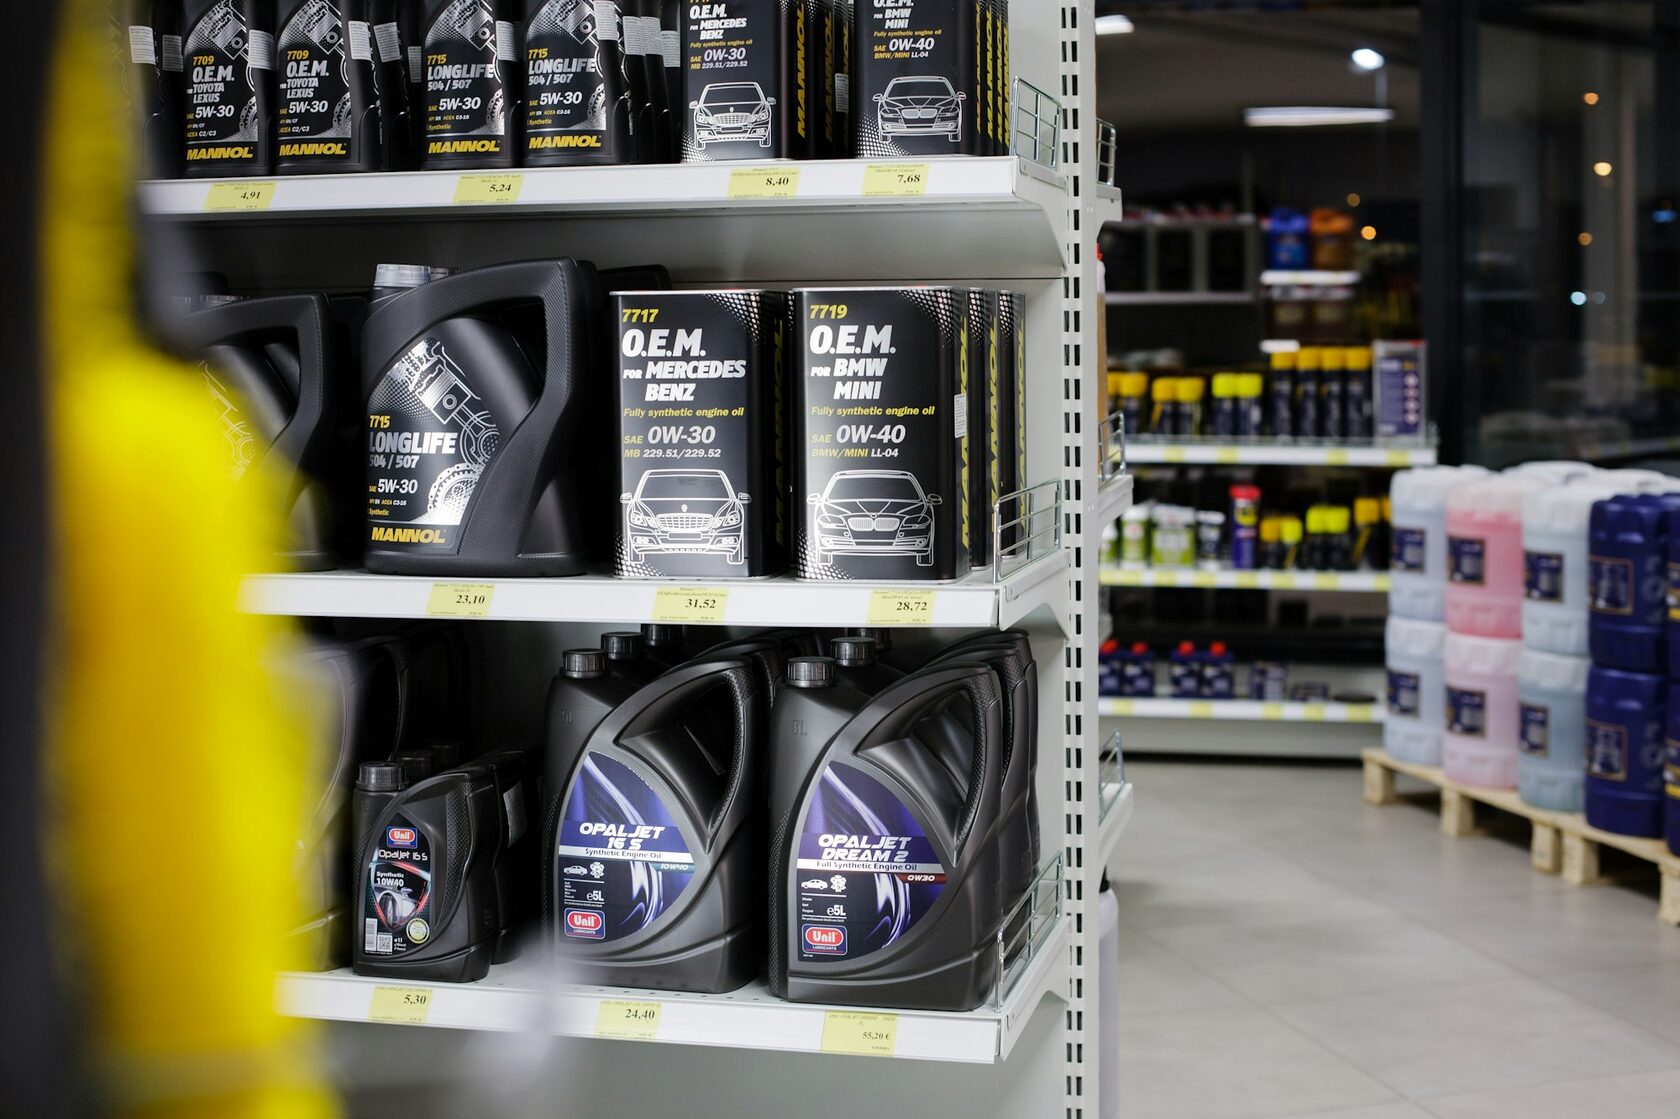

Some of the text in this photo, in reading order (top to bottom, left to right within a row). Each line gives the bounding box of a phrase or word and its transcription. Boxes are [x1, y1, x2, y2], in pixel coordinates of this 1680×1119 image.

[690, 4, 727, 19] O.E.M.
[885, 8, 911, 18] BMW
[700, 18, 747, 30] MERCEDES
[885, 19, 909, 29] MINI
[700, 30, 724, 40] BENZ
[889, 37, 935, 51] 0W-40
[193, 55, 215, 65] 7709
[287, 50, 309, 60] 7709
[427, 54, 447, 64] 7715
[528, 48, 548, 59] 7715
[704, 48, 746, 61] 0W-30
[286, 60, 330, 78] O.E.M.
[528, 58, 596, 75] LONGLIFE
[702, 61, 748, 69] 229.51/229.52
[797, 2, 805, 139] MANNOL
[192, 65, 235, 83] O.E.M.
[427, 64, 494, 81] LONGLIFE
[287, 77, 319, 88] TOYOTA
[428, 81, 444, 91] 504
[452, 80, 472, 89] 507
[529, 76, 545, 86] 504
[553, 74, 573, 84] 507
[193, 82, 224, 93] TOYOTA
[287, 88, 314, 99] LEXUS
[193, 93, 220, 104] LEXUS
[439, 97, 481, 111] 5W-30
[539, 92, 582, 105] 5W-30
[195, 105, 235, 119] 5W-30
[289, 100, 329, 113] 5W-30
[428, 140, 501, 154] MANNOL
[529, 135, 602, 149] MANNOL
[186, 147, 254, 161] MANNOL
[279, 143, 347, 156] MANNOL
[622, 309, 659, 323] 7717
[810, 305, 848, 319] 7719
[622, 328, 706, 357] O.E.M.
[809, 325, 896, 354] O.E.M.
[623, 360, 746, 379] FOR MERCEDES
[811, 358, 888, 377] FOR BMW
[645, 383, 696, 402] BENZ
[833, 381, 881, 400] MINI
[624, 407, 744, 419] Fully synthetic engine oil
[811, 406, 935, 417] Fully synthetic engine oil
[370, 415, 390, 429] 7715
[624, 425, 716, 444] SAE 0W-30
[811, 424, 906, 444] SAE 0W-40
[369, 432, 458, 454] LONGLIFE
[624, 449, 721, 459] MB 229.51/229.52
[812, 448, 899, 459] BMW/MINI LL-04
[395, 455, 420, 469] 507
[377, 478, 418, 494] 5W-30
[369, 508, 389, 517] Synthetic
[371, 527, 445, 544] MANNOL
[394, 831, 410, 840] Unil
[579, 822, 665, 839] OPALJET
[607, 837, 643, 851] 16 S
[818, 834, 912, 850] OPALJET
[421, 852, 428, 861] S
[585, 848, 619, 857] Synthetic
[622, 850, 649, 859] Engine
[821, 848, 909, 862] DREAM 2
[833, 862, 872, 870] Synthetic
[873, 863, 903, 871] Engine
[376, 878, 404, 887] 10W40
[573, 915, 596, 927] Unil
[813, 930, 837, 943] Unil
